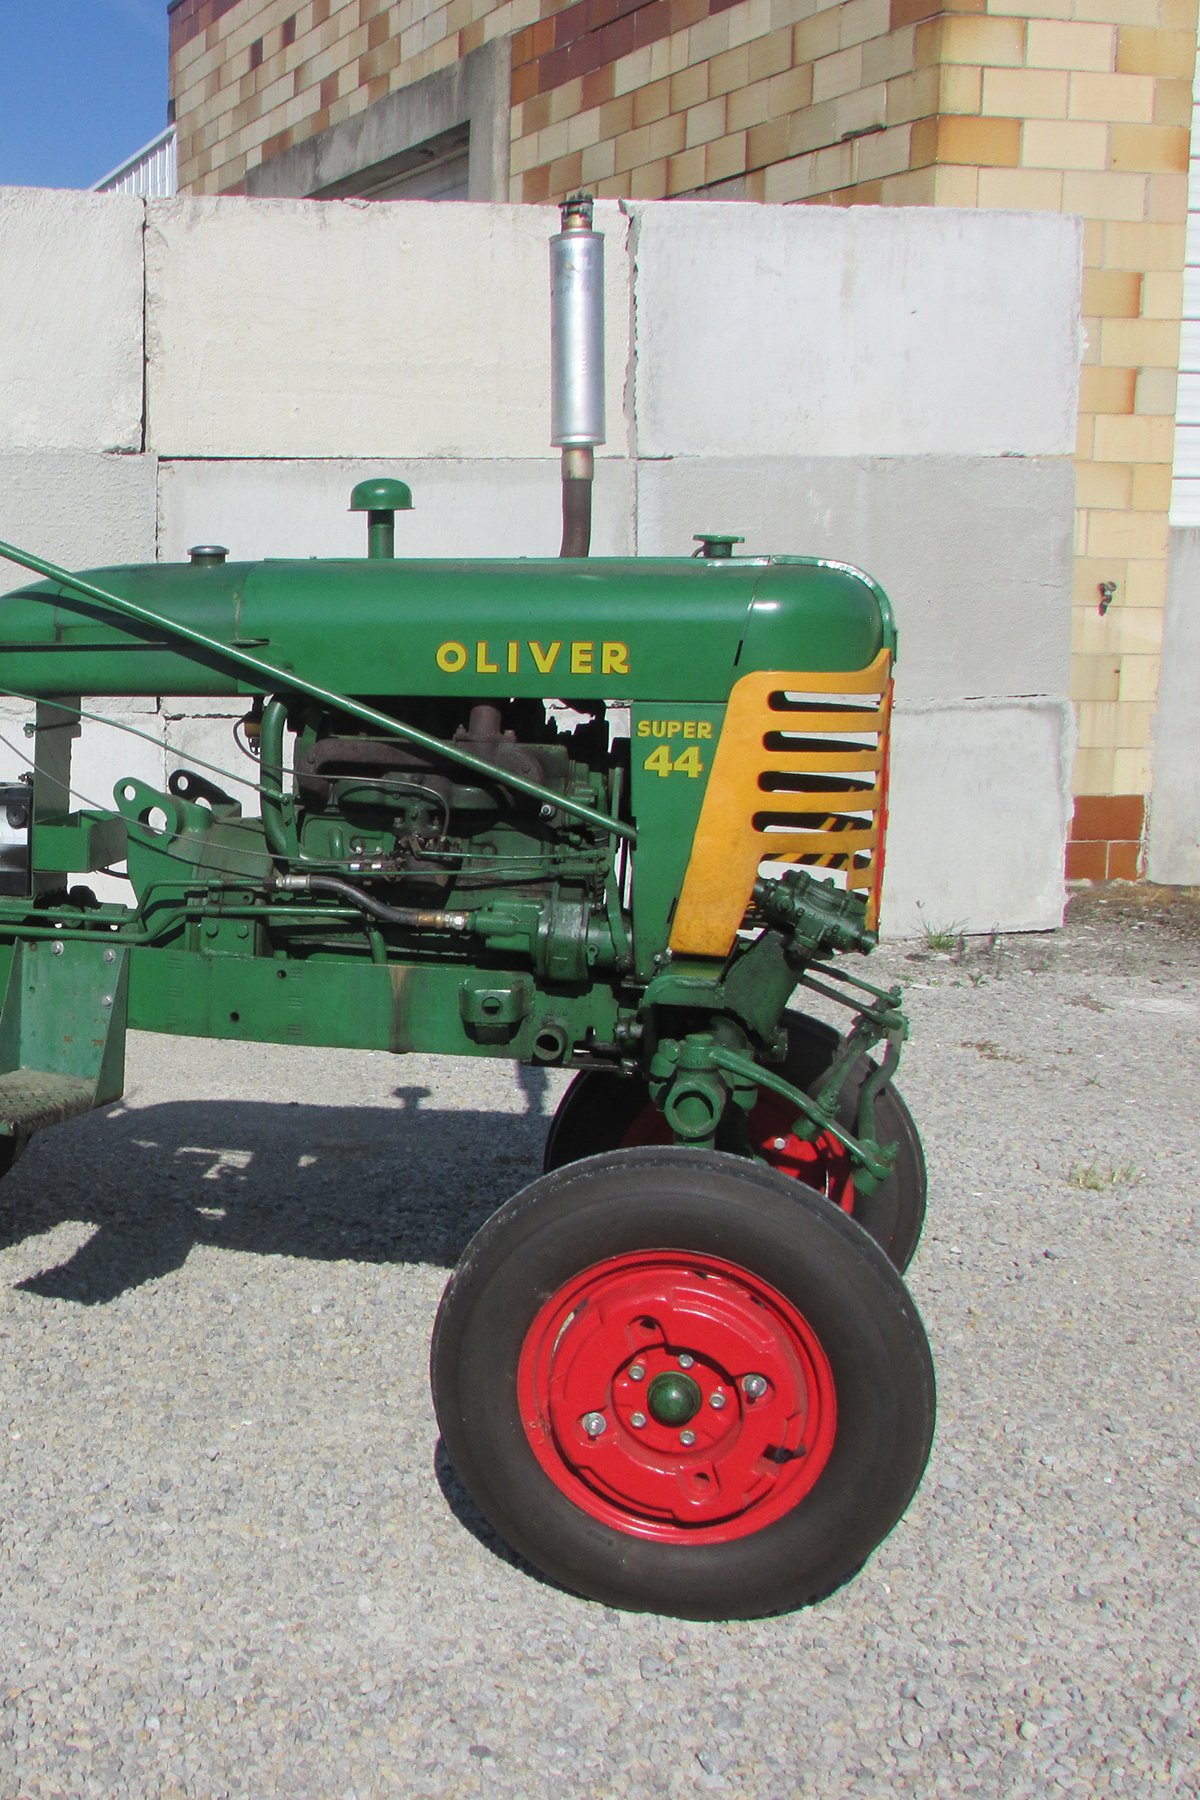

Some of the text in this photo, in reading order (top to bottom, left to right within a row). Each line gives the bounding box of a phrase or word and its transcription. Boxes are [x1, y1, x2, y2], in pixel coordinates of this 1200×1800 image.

[436, 641, 630, 674] OLIVER
[637, 720, 712, 739] SUPER
[643, 745, 704, 778] 44
